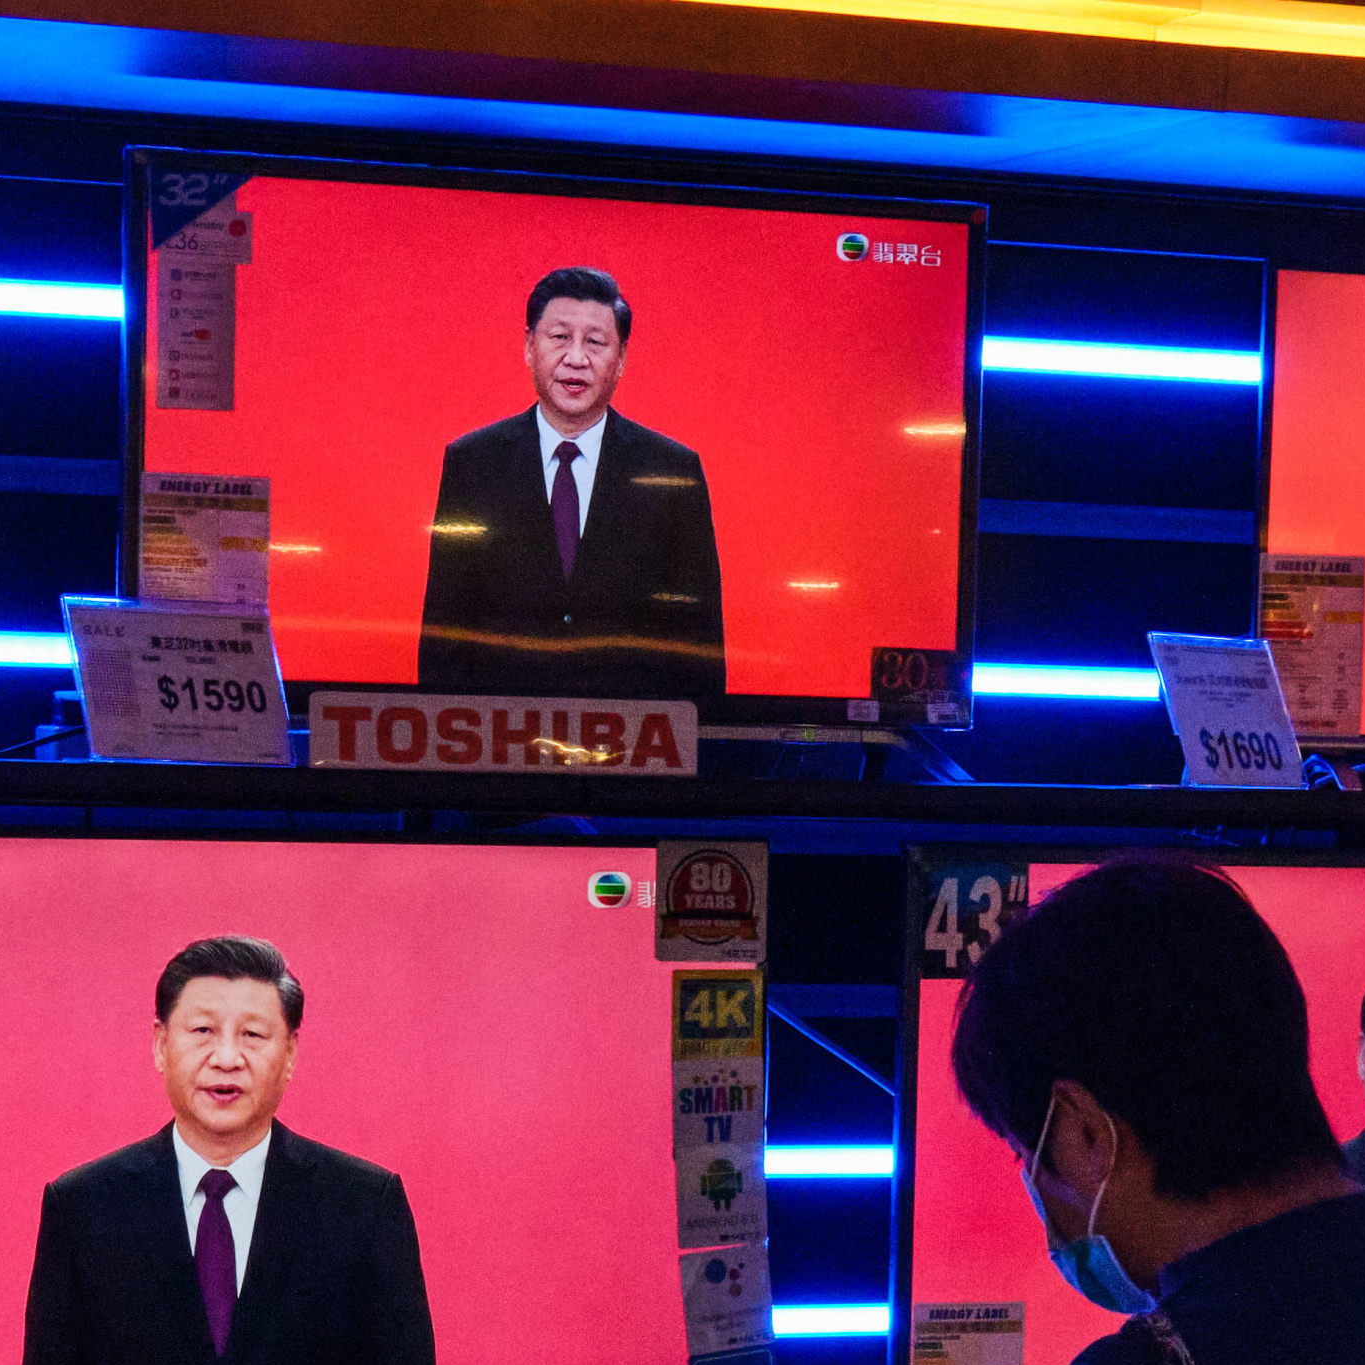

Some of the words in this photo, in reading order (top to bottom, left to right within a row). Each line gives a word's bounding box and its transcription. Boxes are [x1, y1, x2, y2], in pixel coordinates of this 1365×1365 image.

[873, 242, 941, 267] 翡翠台
[160, 480, 210, 494] ENERGY
[215, 481, 254, 497] LABEL
[157, 674, 267, 713] $1590
[323, 705, 682, 769] TOSHIBA
[1199, 728, 1283, 771] $1690
[690, 862, 732, 892] 80
[685, 894, 736, 910] YEARS
[685, 990, 747, 1028] 4K
[679, 1085, 757, 1114] SMART
[704, 1115, 732, 1143] TV
[929, 1308, 971, 1320] ENERGY
[975, 1308, 1009, 1320] LABEL
